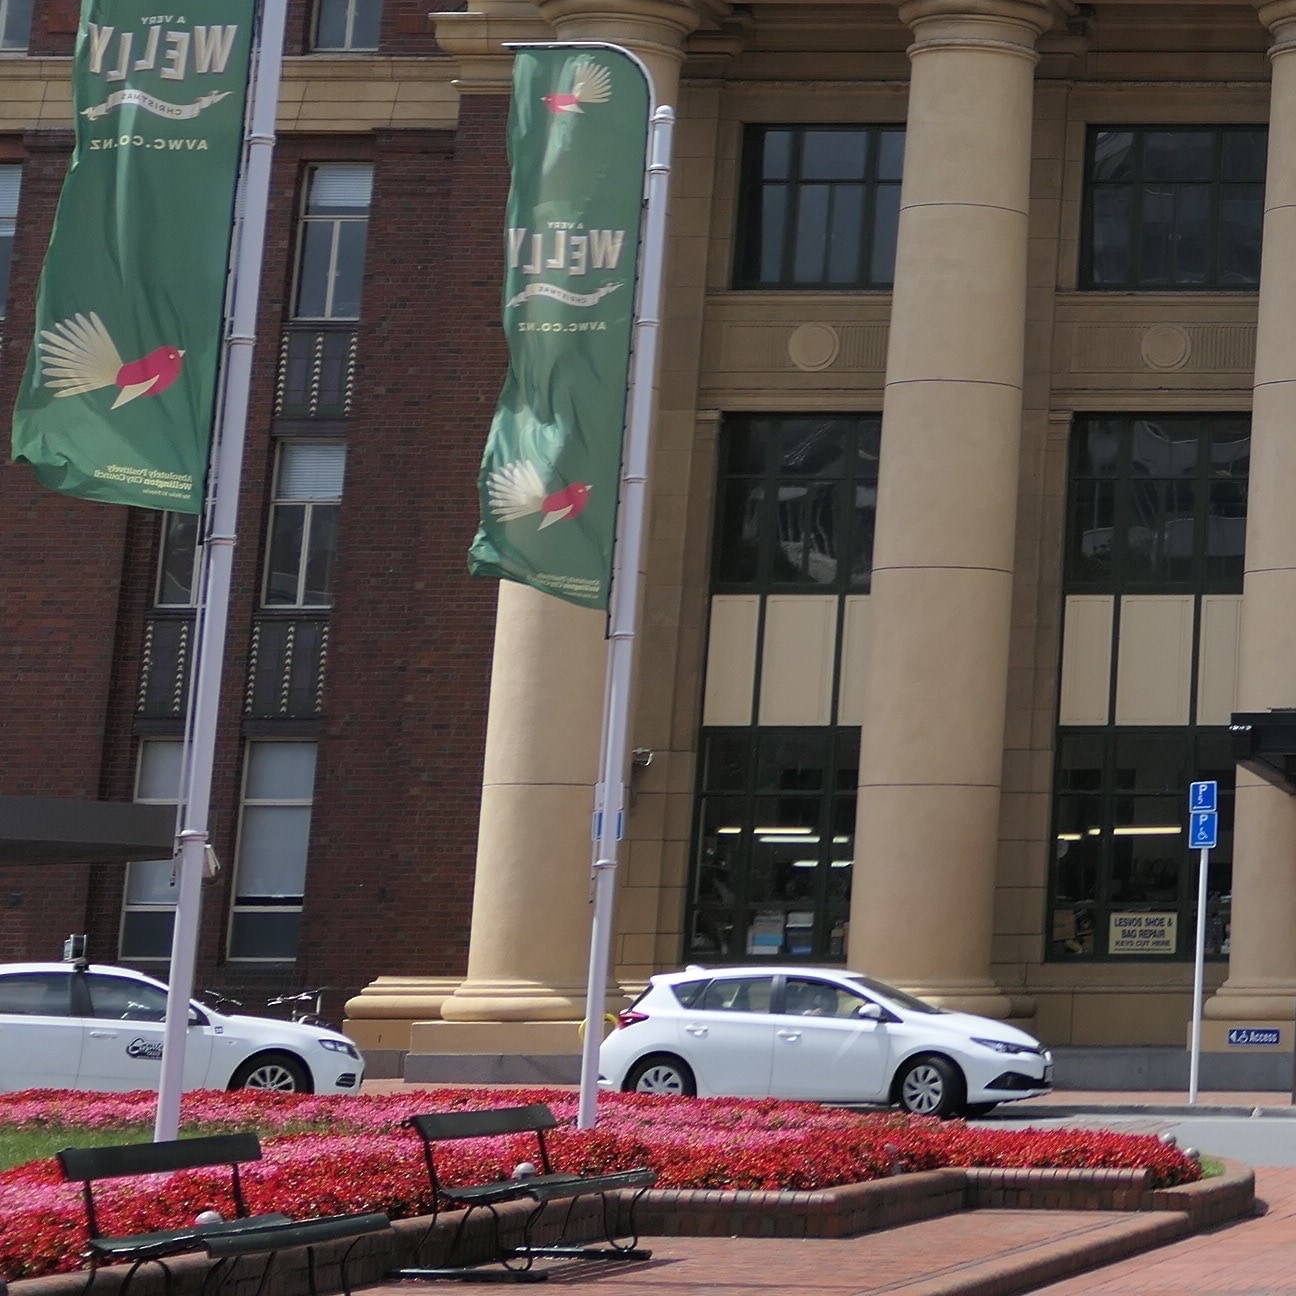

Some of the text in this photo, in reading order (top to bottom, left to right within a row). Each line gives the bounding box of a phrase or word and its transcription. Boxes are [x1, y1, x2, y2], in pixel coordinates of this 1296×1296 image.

[1199, 784, 1208, 795] P
[1199, 814, 1209, 826] P
[1115, 917, 1173, 927] LESVOS SHOE &
[1121, 929, 1166, 939] BAG REPAIR
[1249, 1031, 1278, 1043] Access
